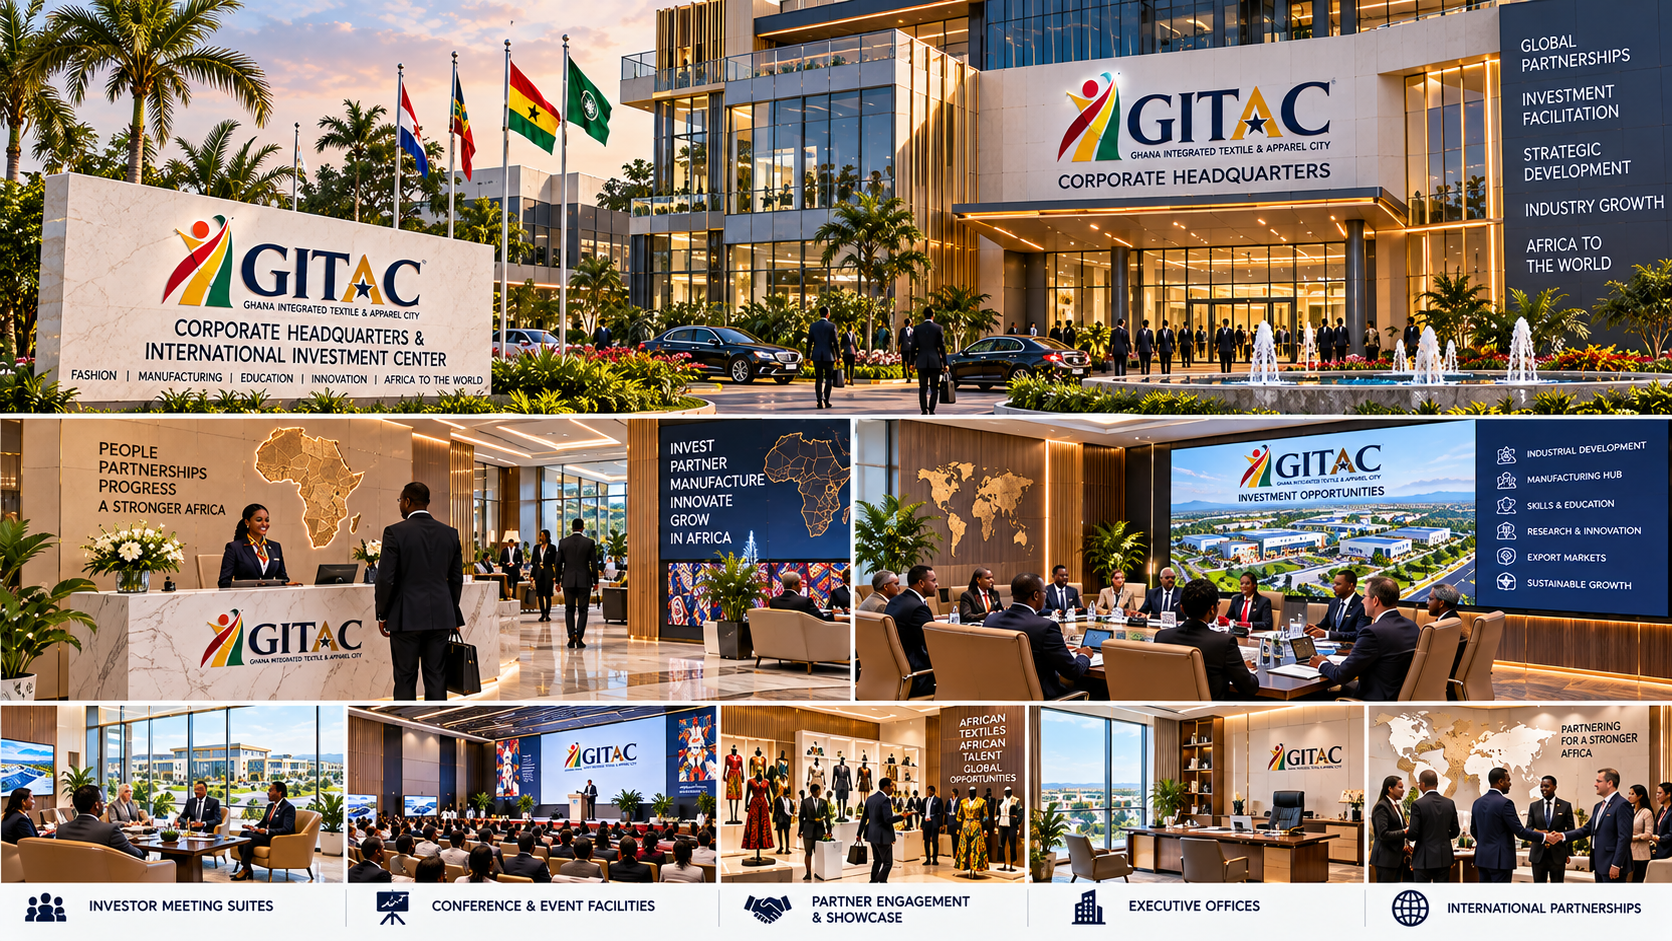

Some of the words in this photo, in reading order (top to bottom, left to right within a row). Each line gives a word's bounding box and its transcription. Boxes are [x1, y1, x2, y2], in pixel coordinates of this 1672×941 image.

[1521, 35, 1576, 52] GLOBAL
[1522, 48, 1630, 72] PARTNERSHIPS
[1523, 85, 1614, 106] INVESTMENT
[1127, 81, 1330, 145] GITAC
[1524, 104, 1618, 125] FACILITATION
[1131, 151, 1161, 160] GHANA
[1164, 148, 1217, 158] INTEGRATED
[1219, 145, 1253, 155] TEXTILE
[1257, 145, 1264, 154] &
[1266, 143, 1307, 153] APPAREL
[1310, 141, 1331, 151] CITY
[1524, 142, 1600, 161] STRATEGIC
[1059, 171, 1165, 189] CORPORATE
[1174, 163, 1330, 184] HEADQUARTERS
[1525, 160, 1631, 181] DEVELOPMENT
[1526, 200, 1595, 216] INDUSTRY
[1600, 195, 1664, 212] GROWTH
[1527, 238, 1577, 253] AFRICA
[1582, 236, 1601, 250] TO
[1527, 259, 1553, 273] THE
[1558, 257, 1611, 271] WORLD
[241, 243, 421, 306] GITAC
[244, 301, 275, 311] GHANA
[278, 303, 327, 314] INTEGRATED
[330, 307, 359, 317] TEXTILE
[362, 309, 368, 317] &
[370, 310, 402, 320] APPAREL
[404, 312, 420, 320] CITY
[175, 319, 280, 340] CORPORATE
[288, 325, 408, 345] HEADQUARTERS
[415, 331, 424, 345] &
[146, 343, 285, 363] INTERNATIONAL
[293, 348, 388, 365] INVESTMENT
[394, 351, 446, 366] CENTER
[72, 370, 117, 380] FASHION
[139, 372, 222, 382] MANUFACTURING
[241, 373, 293, 383] EDUCATION
[312, 375, 368, 385] INNOVATION
[384, 375, 416, 385] AFRICA
[419, 376, 431, 385] TO
[434, 376, 450, 385] THE
[453, 376, 484, 386] WORLD
[100, 442, 157, 459] PEOPLE
[671, 439, 714, 454] INVEST
[1527, 447, 1576, 457] INDUSTRIAL
[1579, 441, 1646, 453] DEVELOPMENT
[671, 457, 727, 472] PARTNER
[1276, 445, 1382, 478] GITAC
[100, 461, 207, 479] PARTNERSHIPS
[1528, 472, 1600, 483] MANUFACTURING
[1604, 471, 1623, 480] HUB
[99, 479, 176, 495] PROGRESS
[671, 474, 765, 490] MANUFACTURE
[671, 494, 732, 508] INNOVATE
[1239, 491, 1297, 502] INVESTMENT
[1300, 486, 1384, 499] OPPORTUNITIES
[98, 500, 108, 512] A
[113, 501, 181, 514] STRONGER
[185, 504, 225, 515] AFRICA
[1527, 502, 1554, 511] SKILLS
[1556, 502, 1563, 510] &
[1565, 500, 1615, 509] EDUCATION
[671, 513, 709, 526] GROW
[671, 533, 682, 544] IN
[687, 532, 731, 544] AFRICA
[1528, 528, 1573, 536] RESEARCH
[1575, 527, 1581, 536] &
[1584, 527, 1642, 535] INNOVATION
[1528, 554, 1562, 562] EXPORT
[1564, 554, 1607, 563] MARKETS
[1528, 579, 1587, 589] SUSTAINABLE
[1589, 581, 1632, 590] GROWTH
[248, 620, 362, 655] GITAC
[960, 713, 1005, 727] AFRICAN
[1562, 721, 1620, 733] PARTNERING
[960, 726, 1006, 738] TEXTILES
[1561, 736, 1580, 746] FOR
[1581, 736, 1588, 745] A
[1590, 733, 1637, 744] STRONGER
[959, 738, 1005, 750] AFRICAN
[582, 743, 637, 765] GITAC
[963, 751, 1002, 761] TALENT
[1287, 746, 1342, 765] GITAC
[964, 764, 1003, 774] GLOBAL
